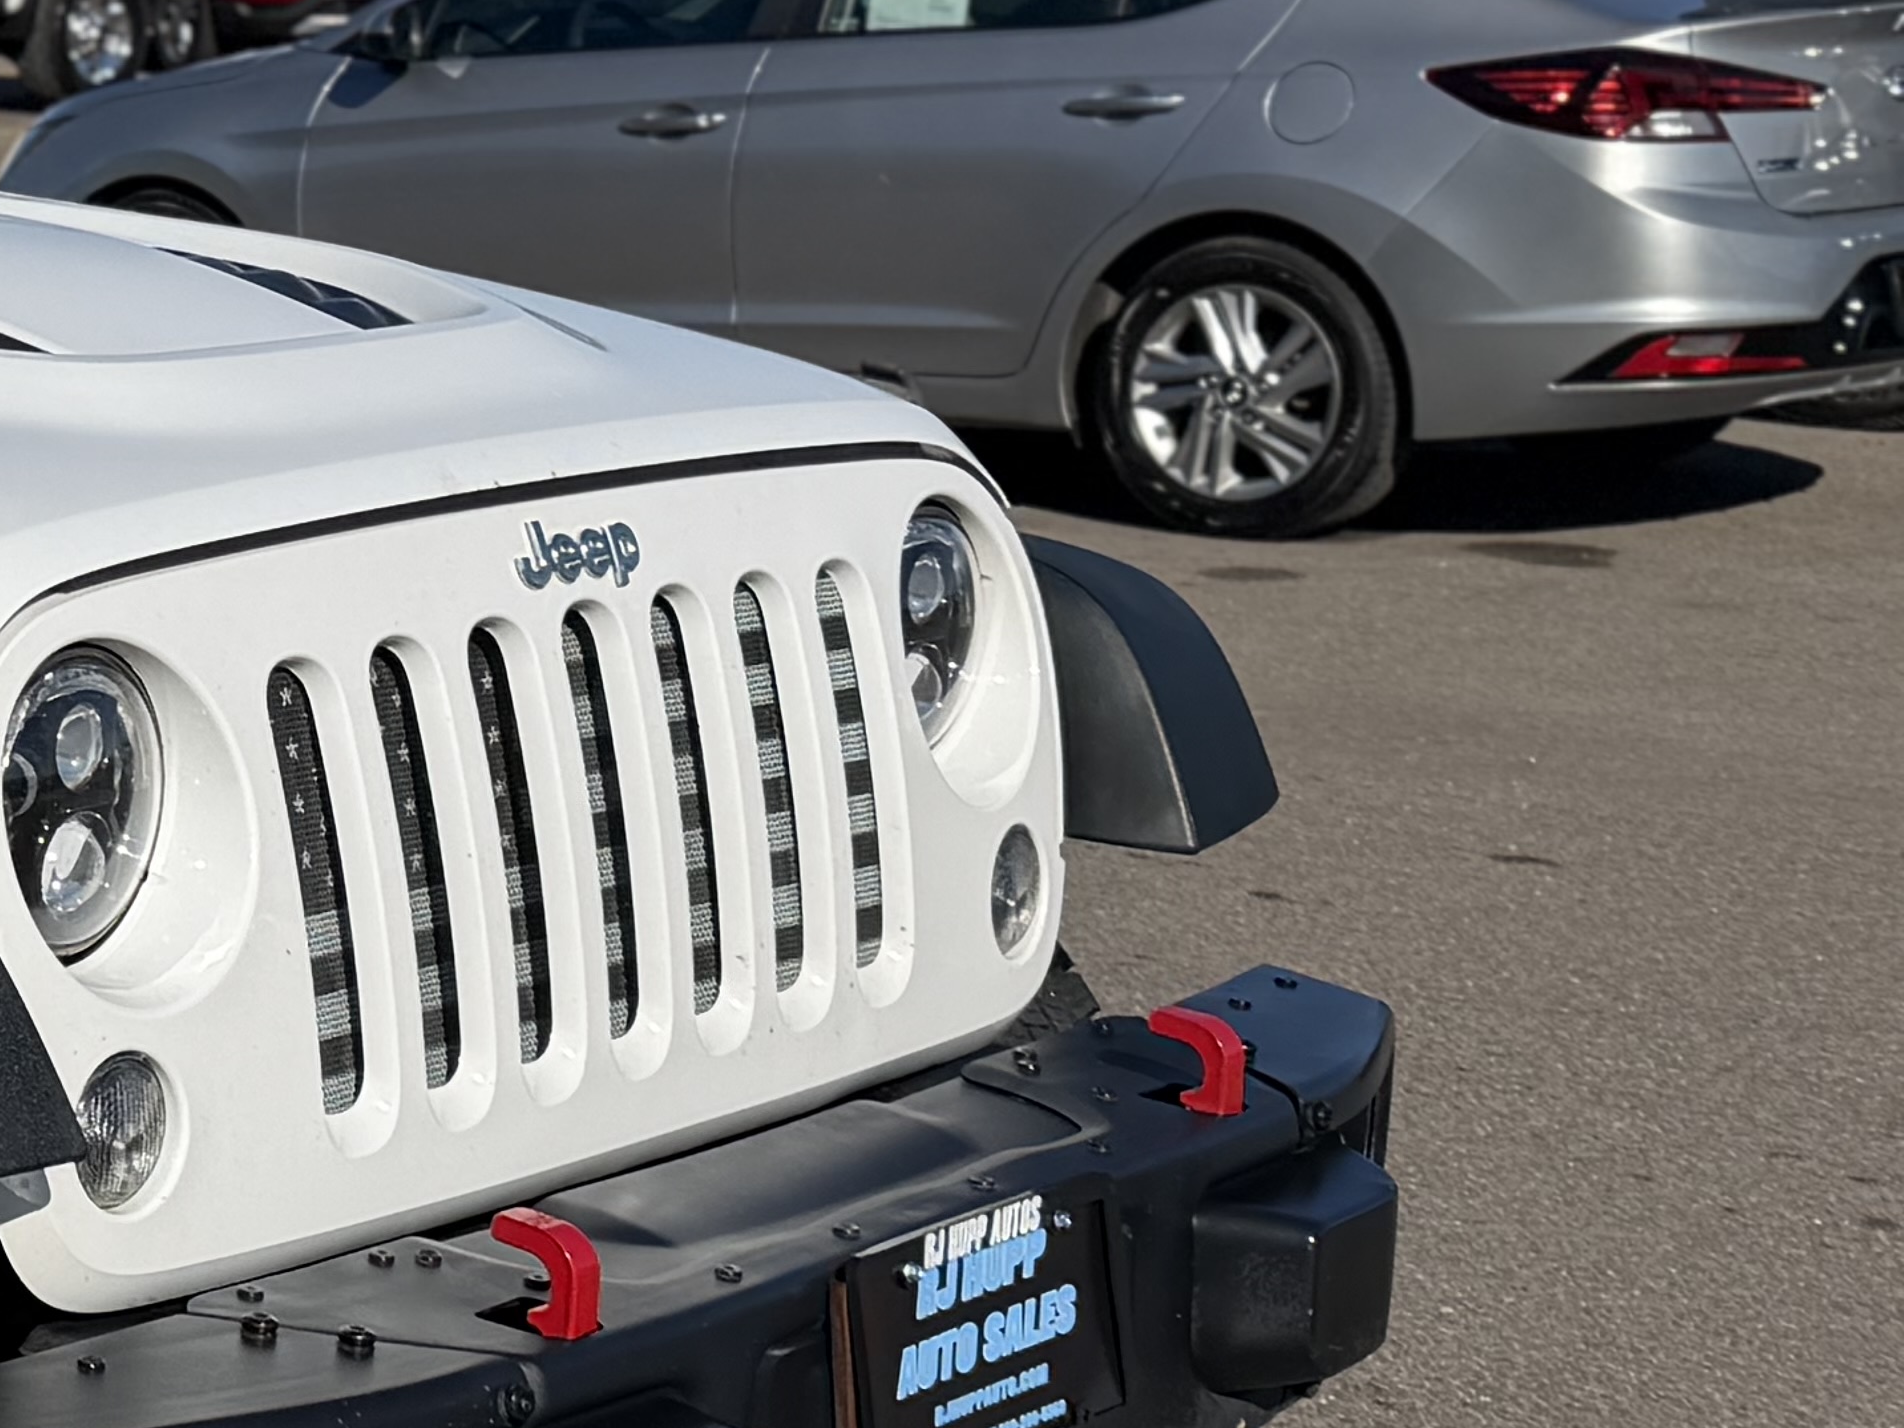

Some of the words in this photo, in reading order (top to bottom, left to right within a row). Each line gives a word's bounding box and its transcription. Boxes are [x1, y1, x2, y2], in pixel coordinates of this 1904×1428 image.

[514, 520, 640, 590] Jeep
[989, 1195, 1043, 1246] AUTOS
[961, 1228, 1047, 1303] HUPP
[896, 1321, 978, 1401] AUTO
[982, 1283, 1078, 1363] SALES
